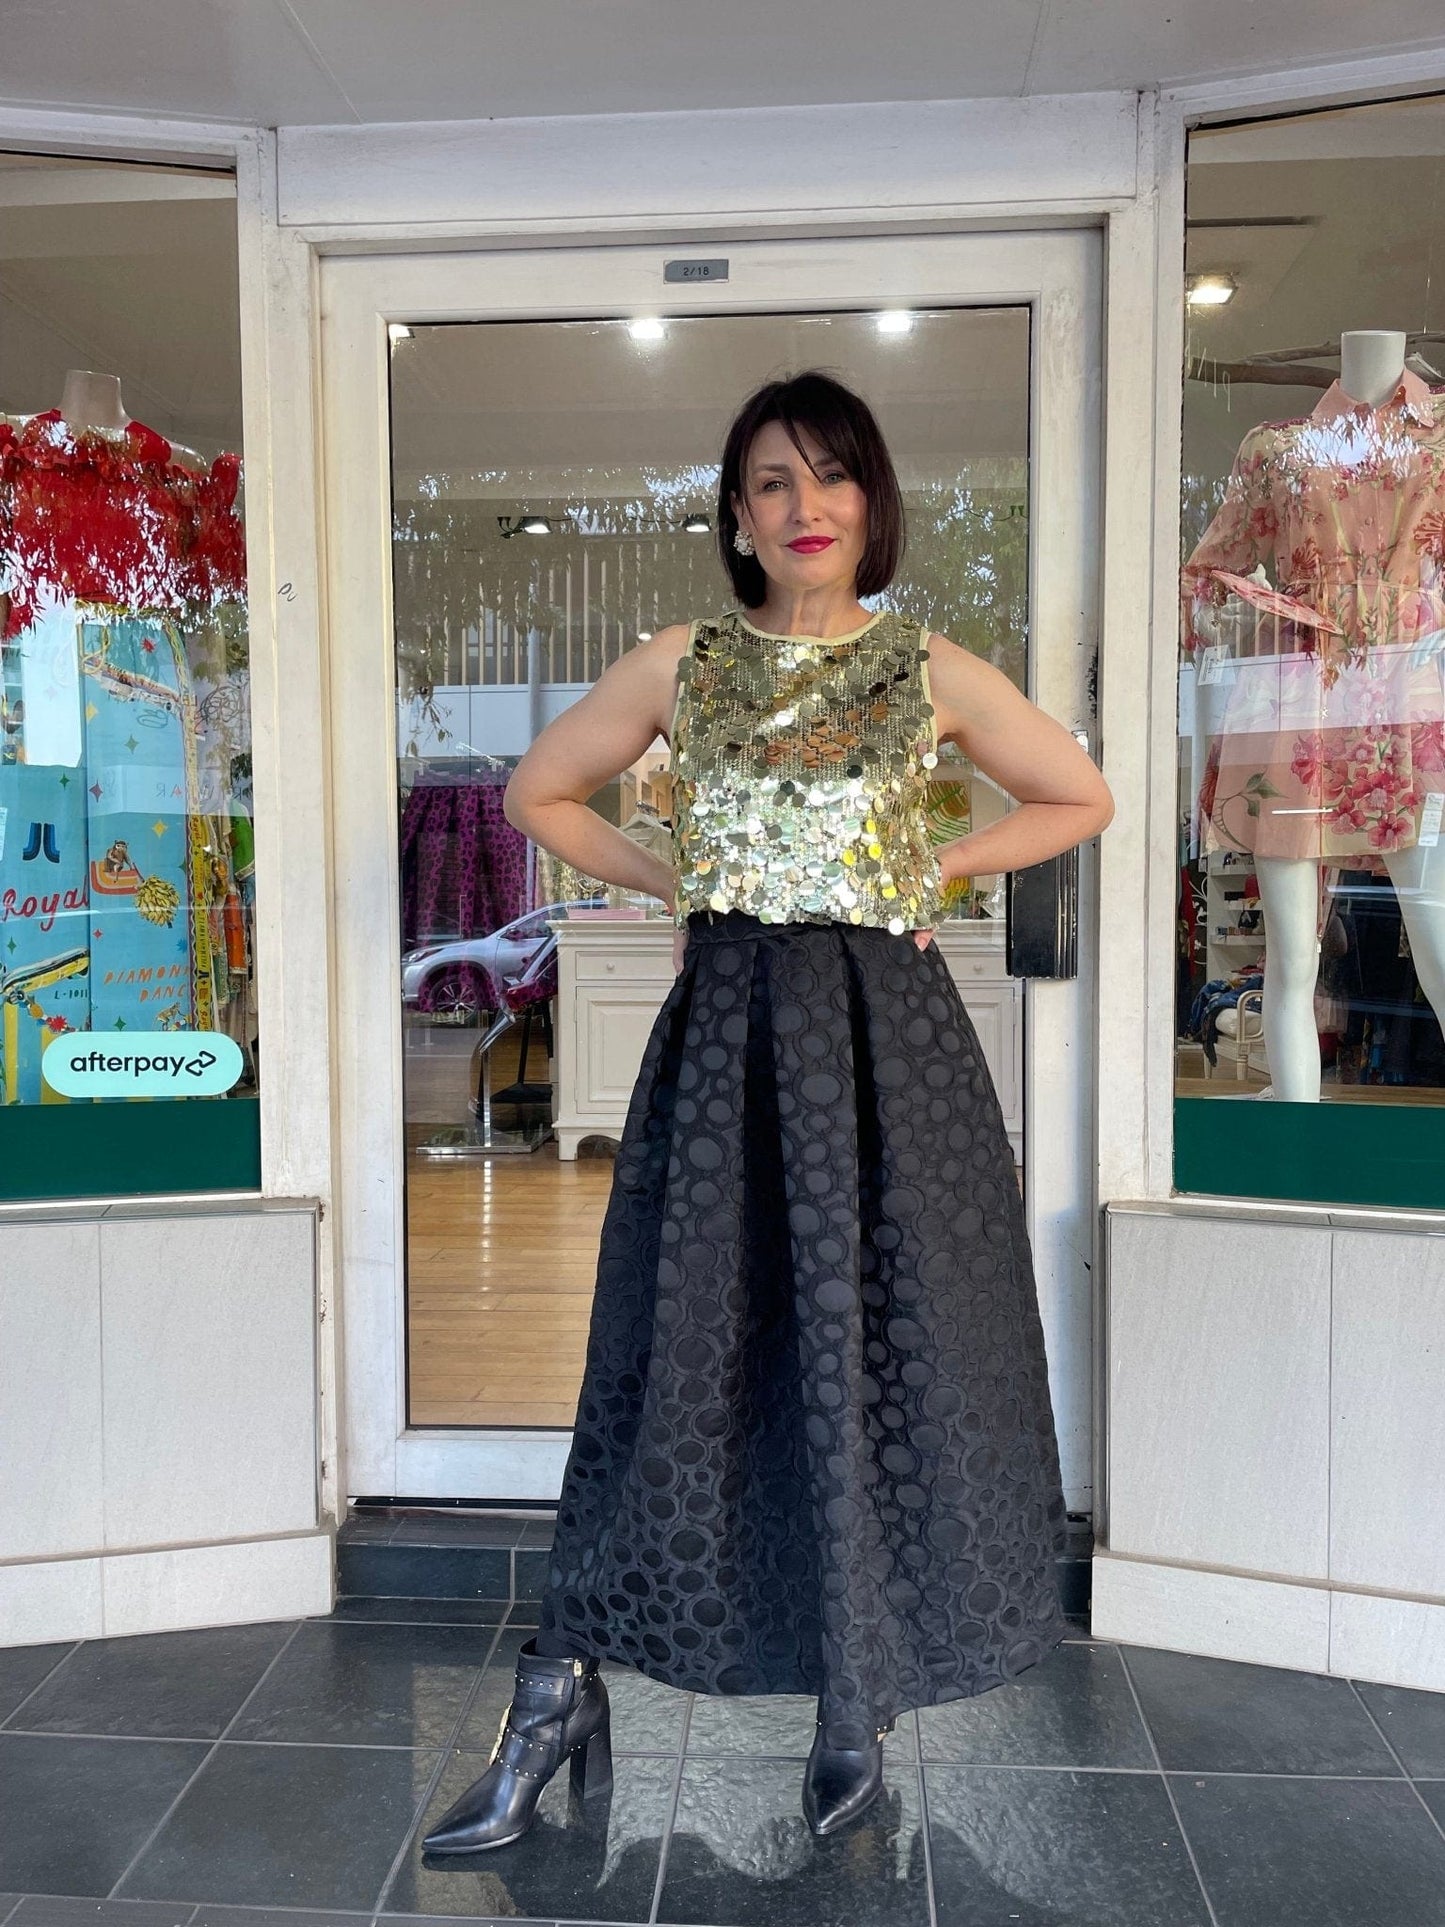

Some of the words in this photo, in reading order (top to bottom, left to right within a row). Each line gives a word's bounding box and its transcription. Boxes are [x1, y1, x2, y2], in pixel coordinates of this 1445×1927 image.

[683, 266, 709, 276] 2/18
[2, 874, 88, 932] Royal
[70, 1051, 186, 1077] afterpay
